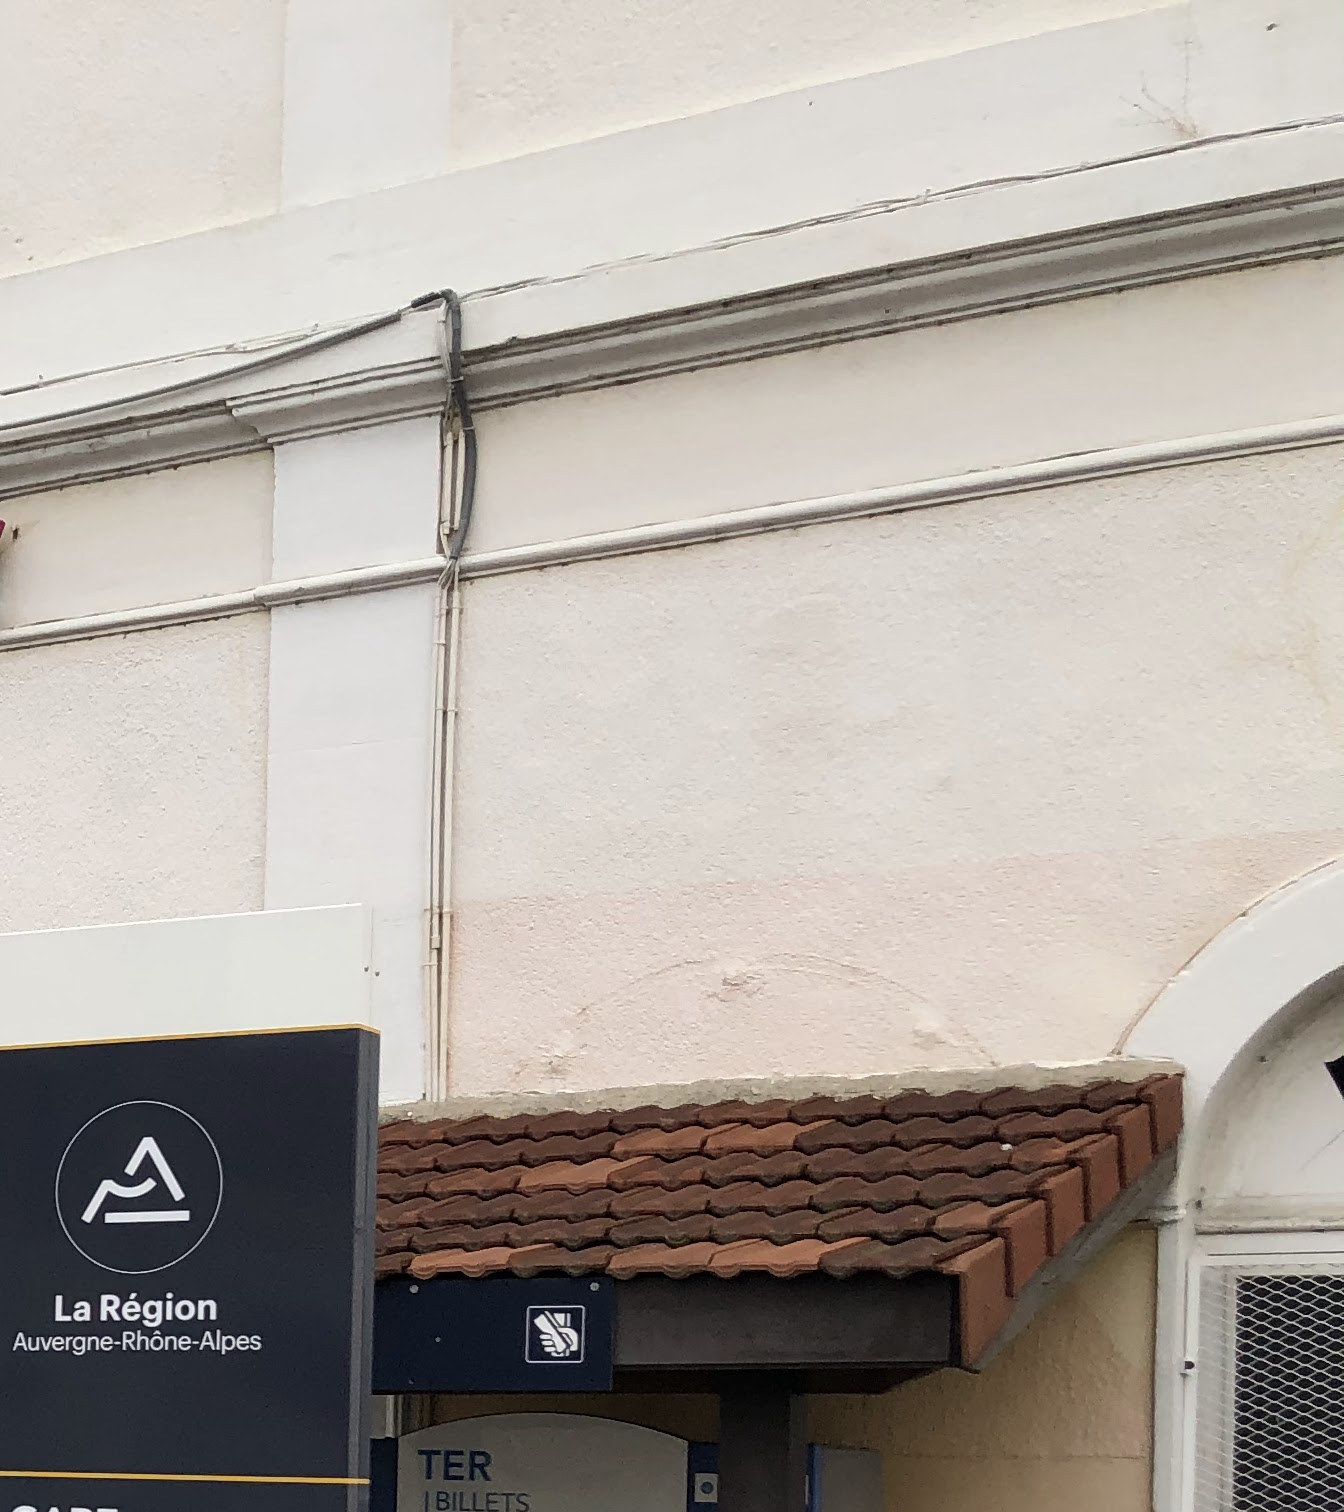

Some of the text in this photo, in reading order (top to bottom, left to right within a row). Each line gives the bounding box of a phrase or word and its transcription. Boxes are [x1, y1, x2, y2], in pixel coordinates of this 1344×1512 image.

[54, 1292, 217, 1327] La Région
[12, 1330, 262, 1355] Auvergne-Rhône-Alpes
[417, 1450, 492, 1482] TER
